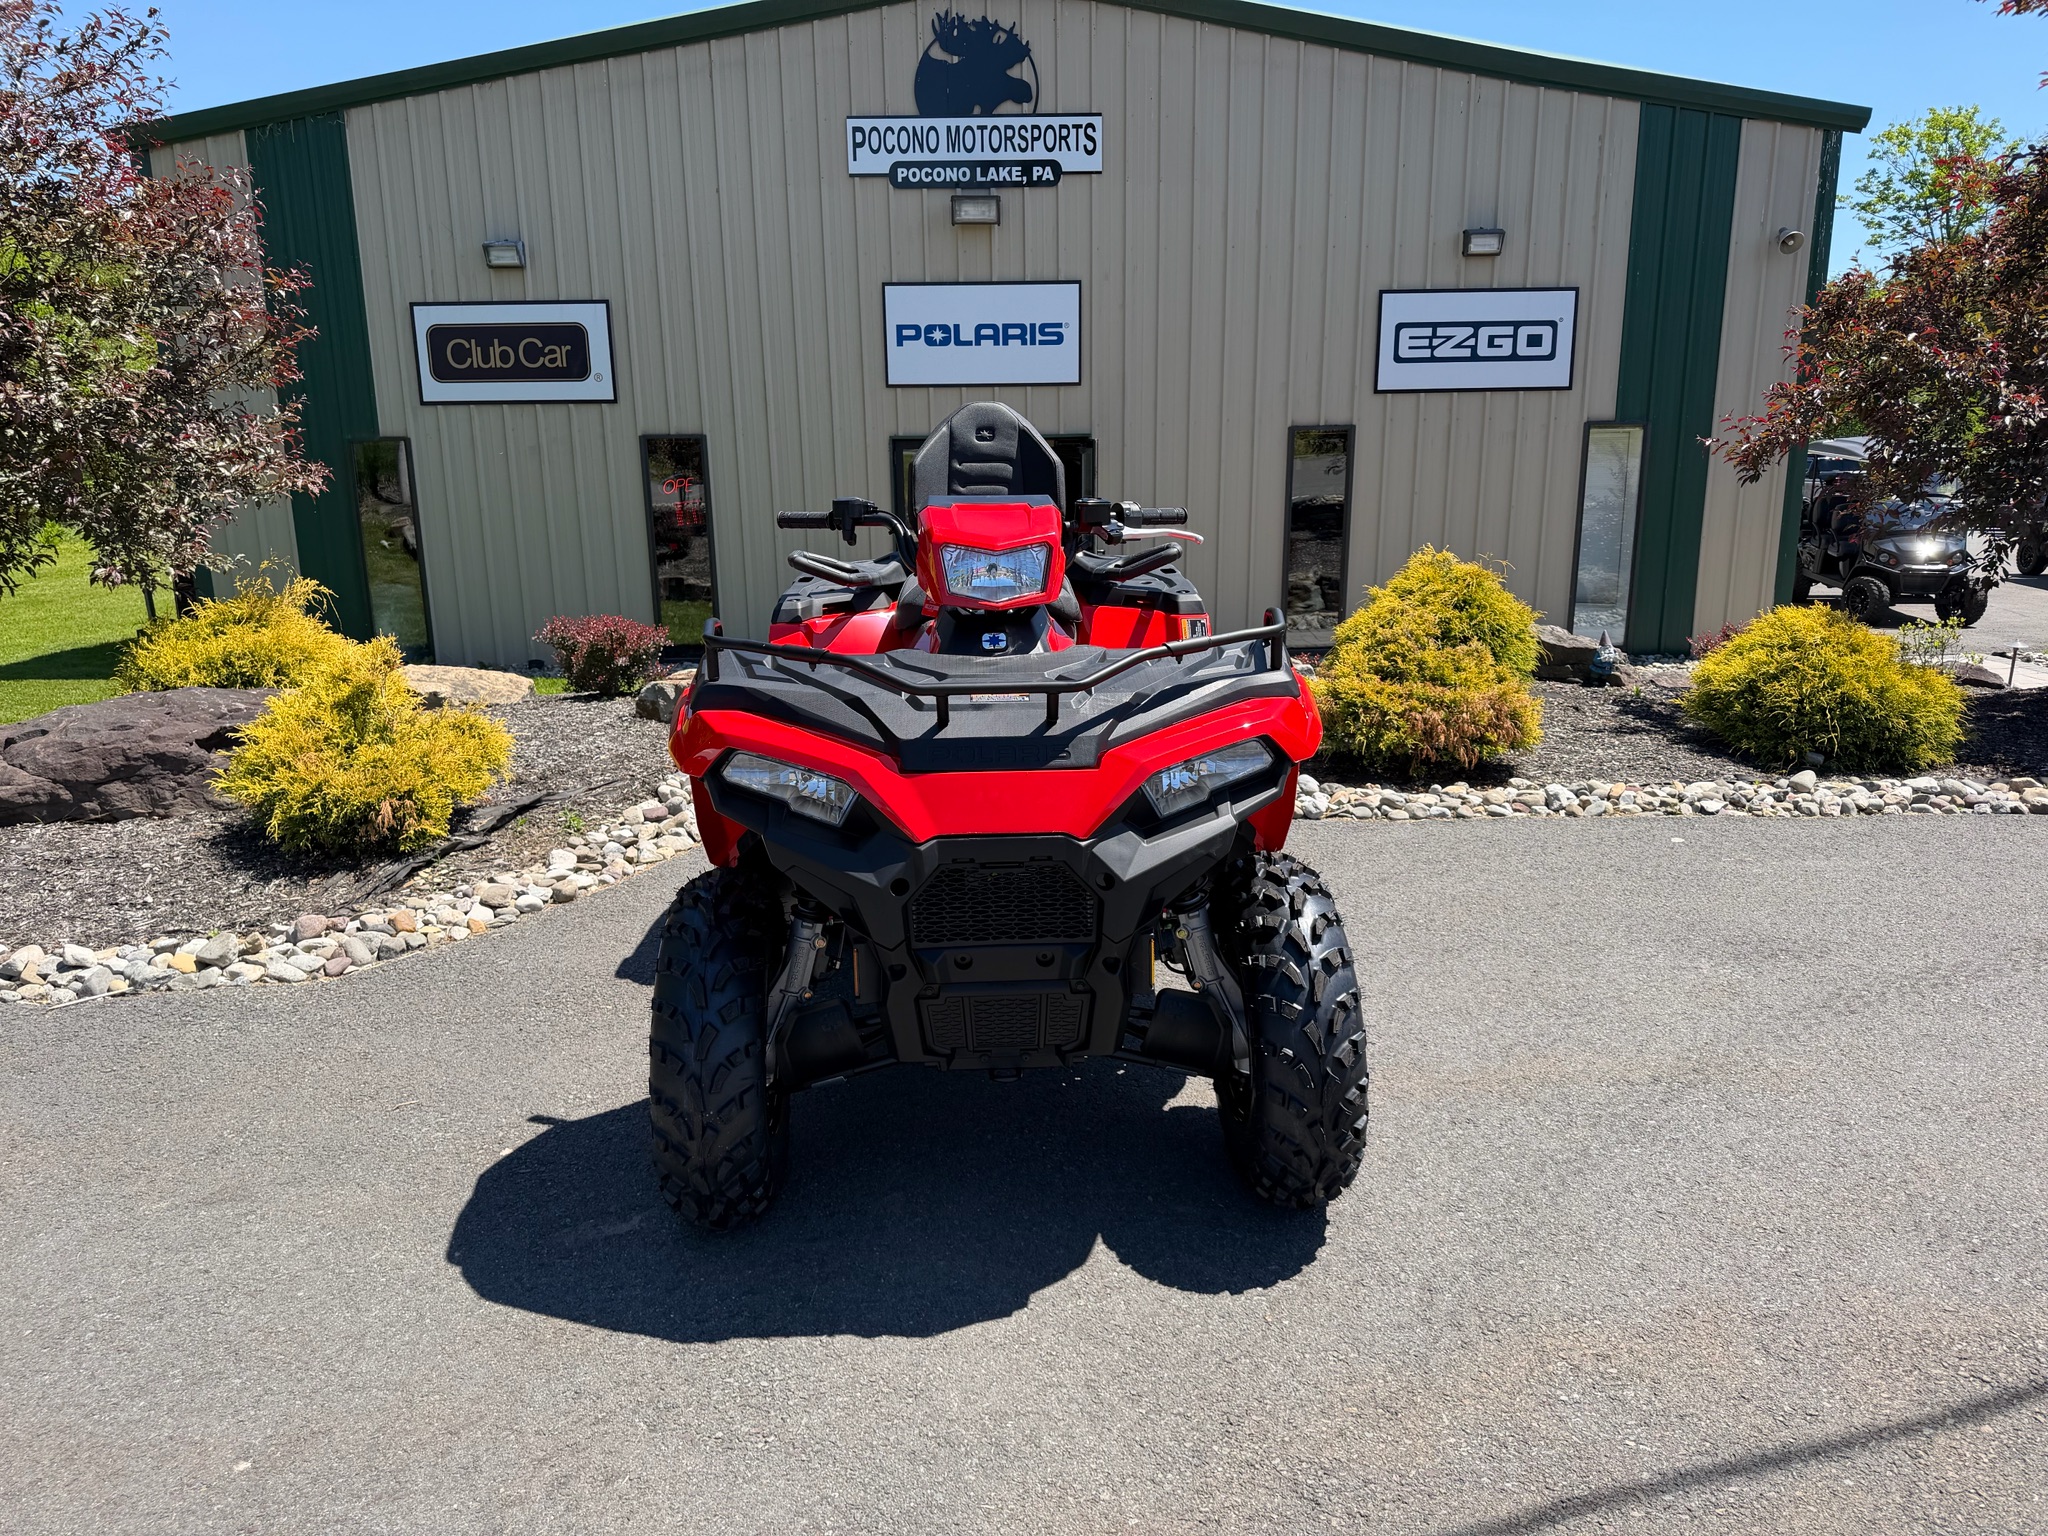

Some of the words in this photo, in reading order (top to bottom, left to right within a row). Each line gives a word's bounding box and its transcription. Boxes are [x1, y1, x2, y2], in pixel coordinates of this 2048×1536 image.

[852, 125, 940, 161] POCONO
[946, 122, 1097, 156] MOTORSPORTS
[897, 166, 971, 183] POCONO
[975, 166, 1028, 185] LAKE,
[1032, 166, 1055, 181] PA
[896, 322, 1065, 347] POLARIS
[446, 338, 515, 369] Club
[518, 337, 572, 369] Car
